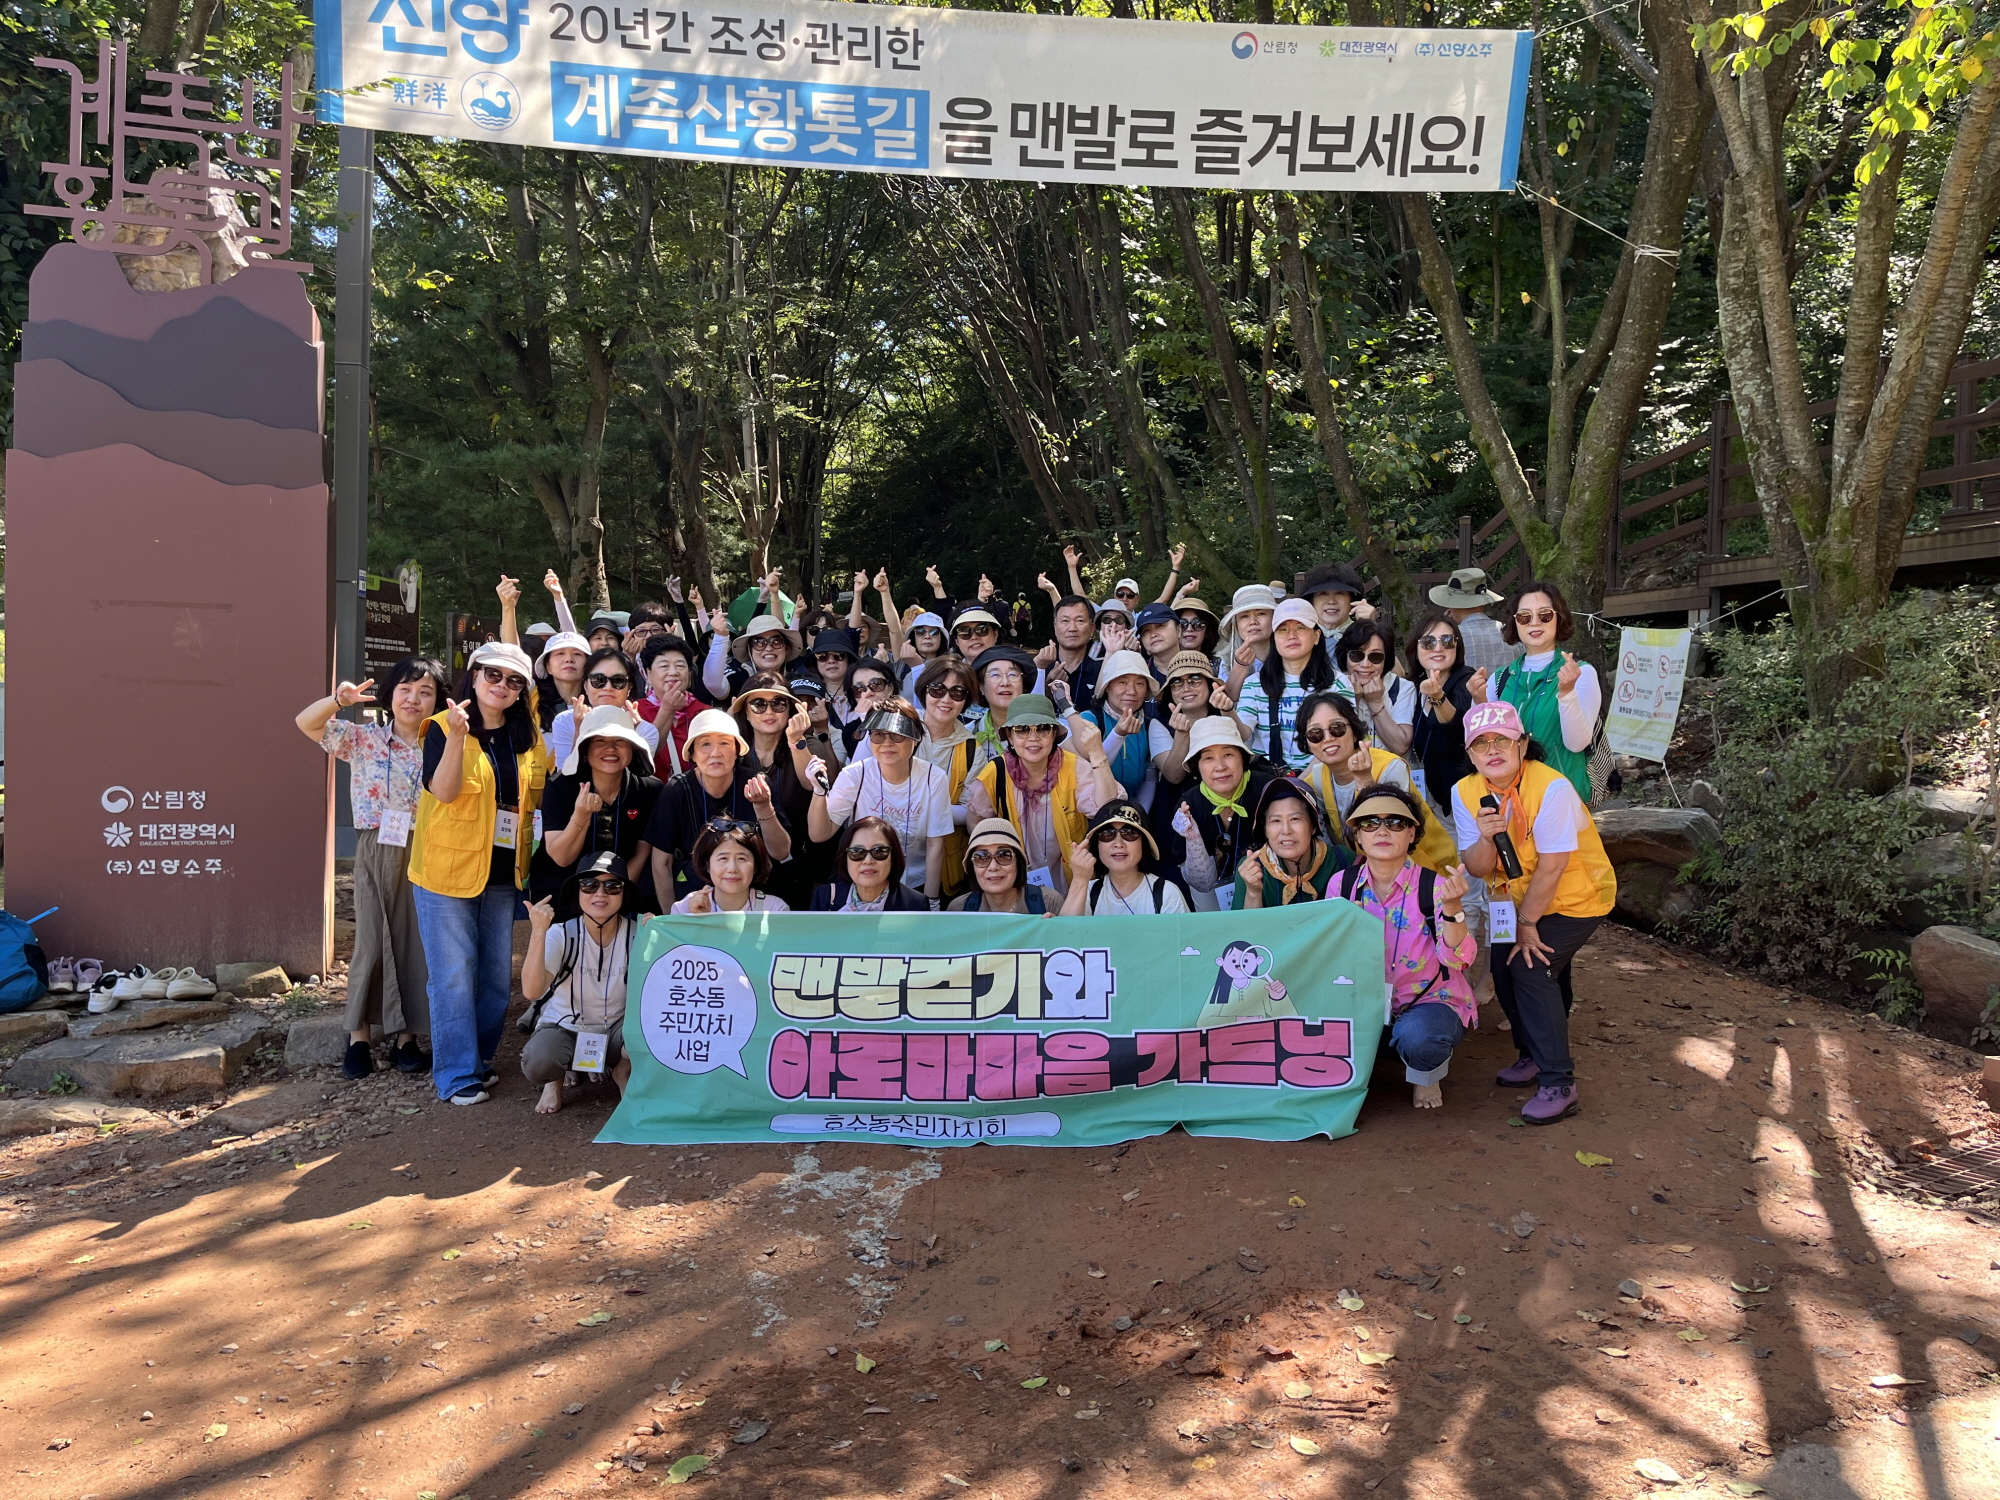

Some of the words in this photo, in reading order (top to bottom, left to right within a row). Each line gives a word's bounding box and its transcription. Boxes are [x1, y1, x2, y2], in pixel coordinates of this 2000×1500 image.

[549, 2, 695, 55] 20년간
[708, 15, 925, 71] 조성·관리한
[1263, 40, 1298, 54] 산림청
[1339, 41, 1398, 54] 대전광역시
[564, 74, 918, 161] 계족산황톳길
[939, 97, 998, 166] 을
[1010, 101, 1179, 172] 맨발로
[1190, 109, 1486, 178] 즐겨보세요!
[1470, 708, 1509, 732] SIX
[142, 790, 206, 810] 산림청
[869, 796, 926, 817] Lovable
[139, 823, 235, 840] 대전광역시
[671, 959, 718, 982] 2025
[668, 985, 726, 1009] 호수동
[771, 949, 1115, 1022] 맨발걷기와
[659, 1011, 733, 1036] 주민자치
[674, 1039, 711, 1062] 사업
[1135, 1018, 1355, 1088] 가드닝
